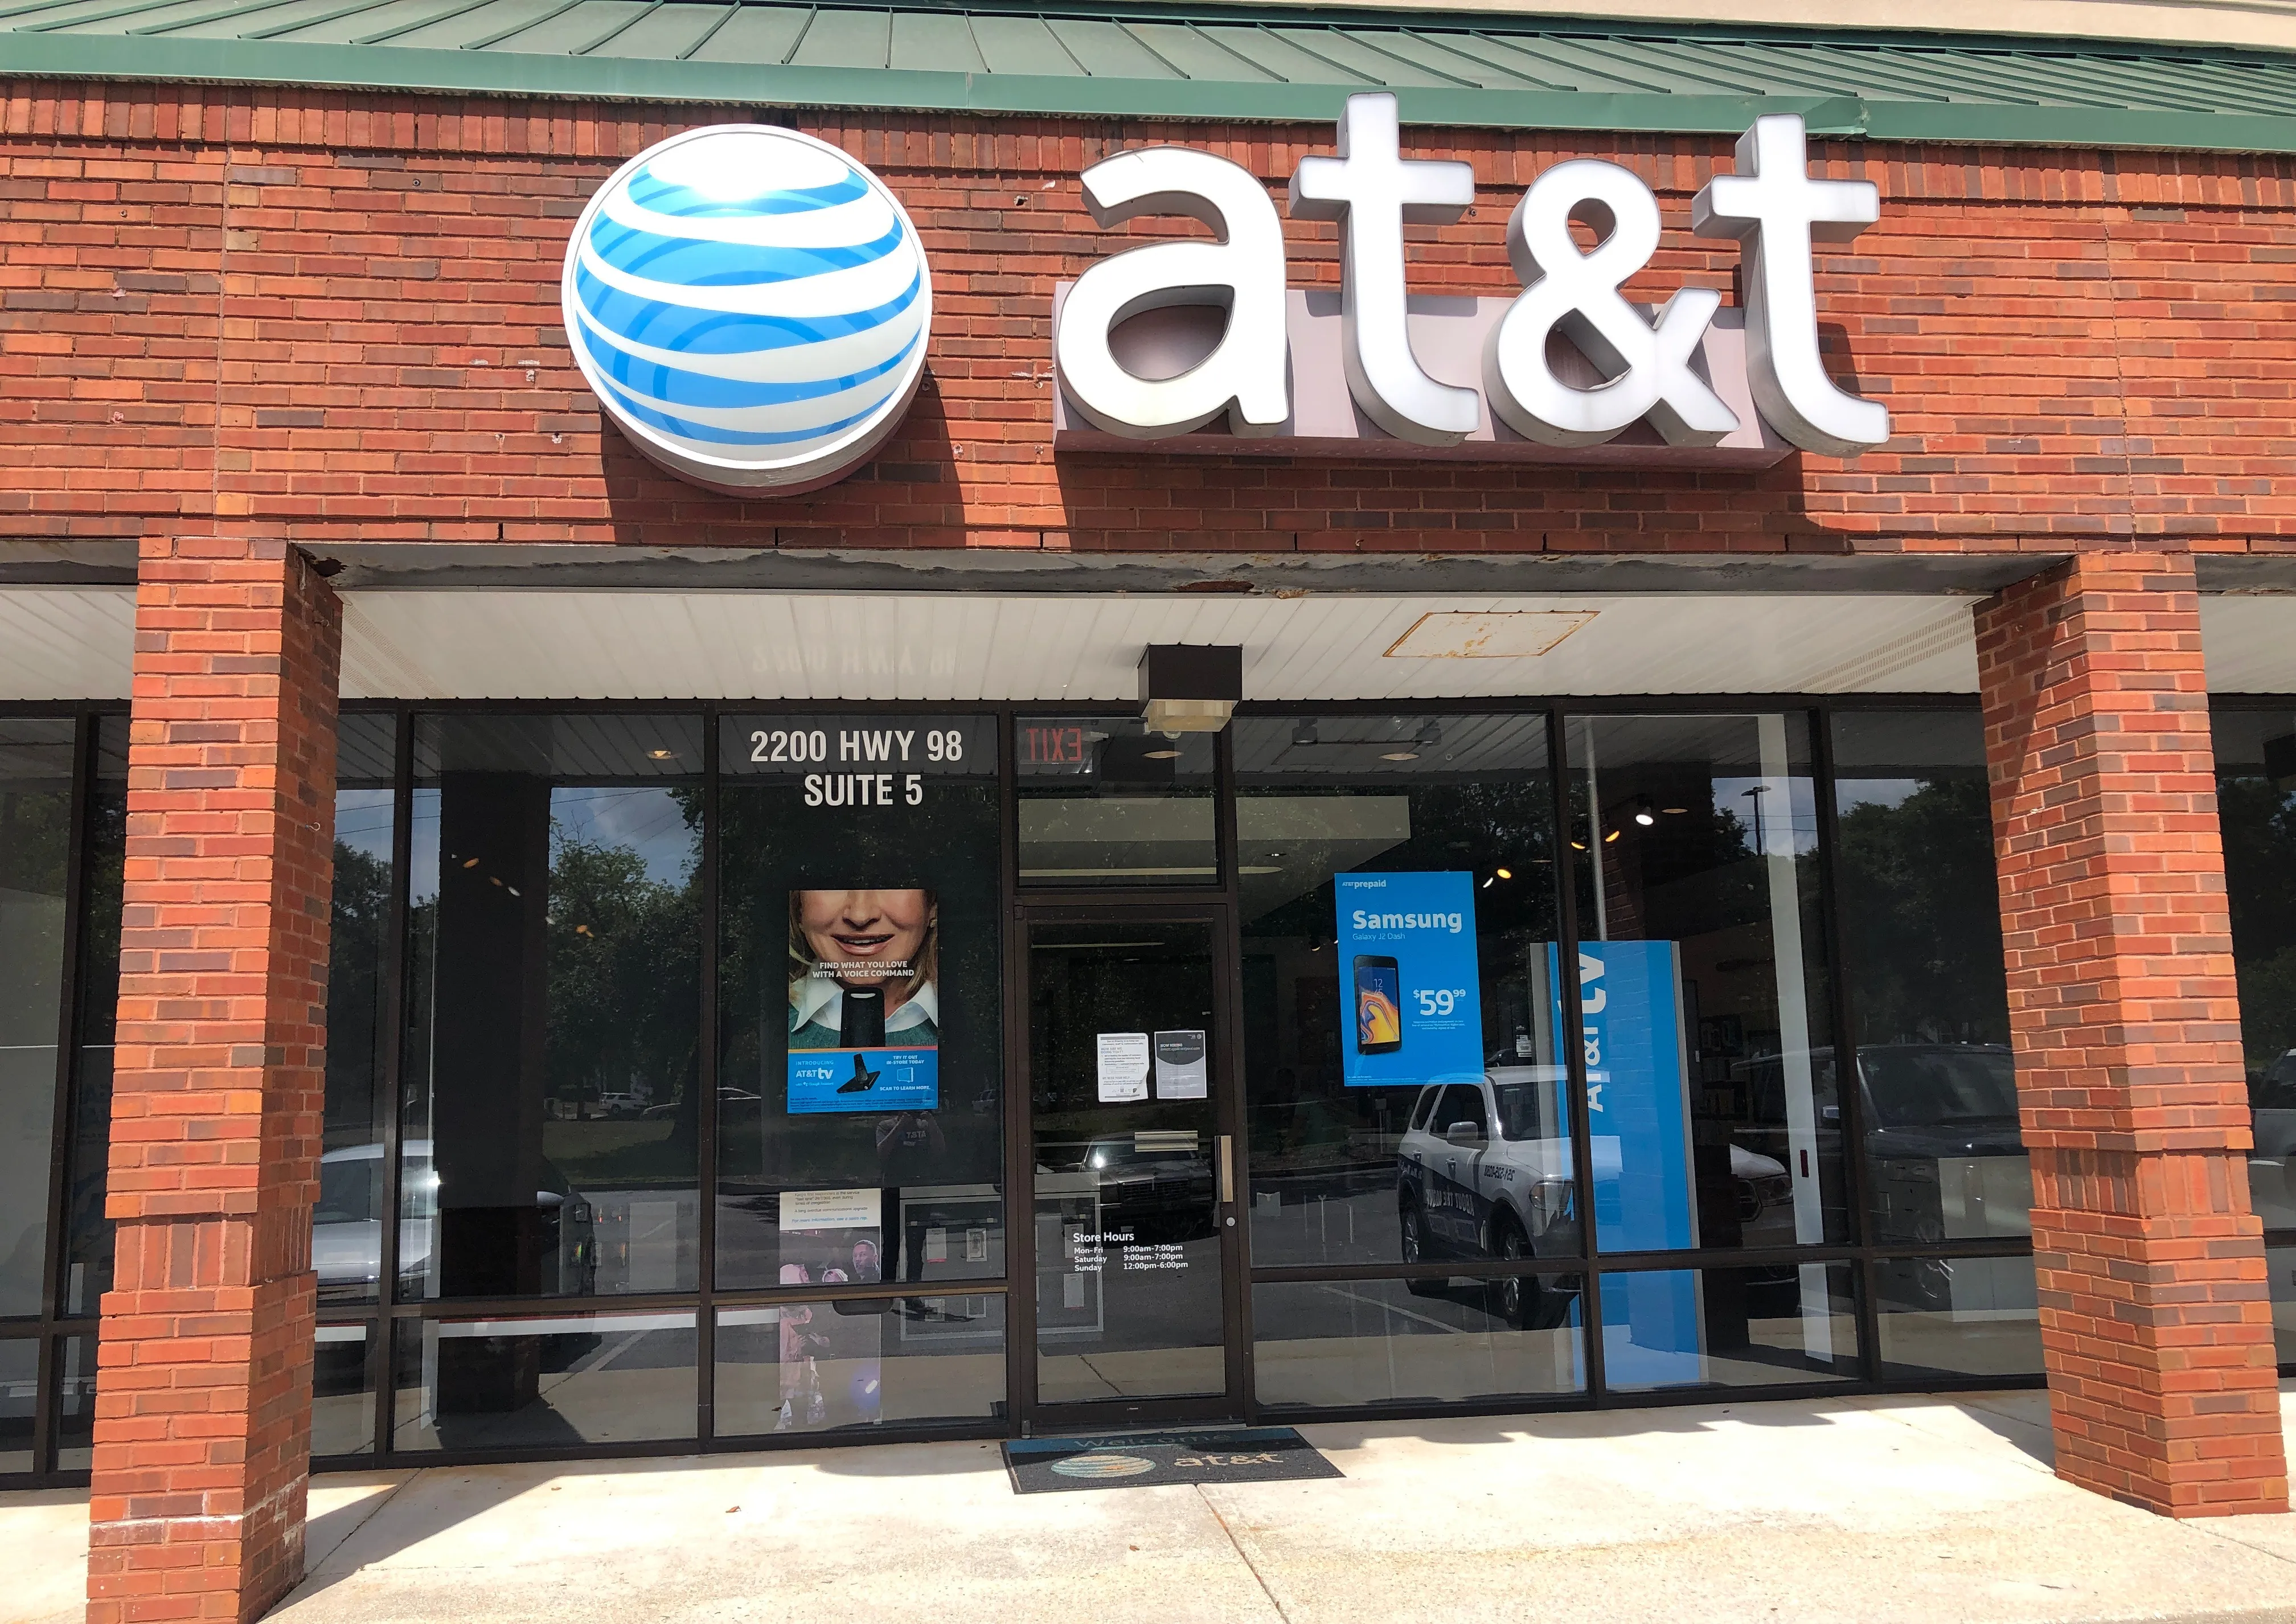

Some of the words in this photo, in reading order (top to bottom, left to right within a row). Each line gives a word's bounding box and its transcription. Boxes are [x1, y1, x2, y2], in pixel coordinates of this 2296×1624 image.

[1057, 92, 1891, 458] at&t
[751, 730, 827, 762] 2200
[839, 731, 916, 761] HWY
[927, 730, 963, 761] 98
[803, 774, 893, 806] SUITE
[905, 773, 923, 805] 5
[1354, 880, 1386, 889] prepaid
[1352, 910, 1462, 933] Samsung
[1374, 979, 1383, 988] 12
[796, 1069, 817, 1078] AT&T
[818, 1068, 834, 1080] tv
[1073, 1233, 1101, 1242] Store
[1103, 1232, 1134, 1241] Hours
[1123, 1245, 1183, 1253] 9:00am-7:00pm
[1123, 1261, 1188, 1270] 12:00pm-6:00pm
[1073, 1433, 1232, 1449] Welcome
[1174, 1452, 1284, 1467] at&t
